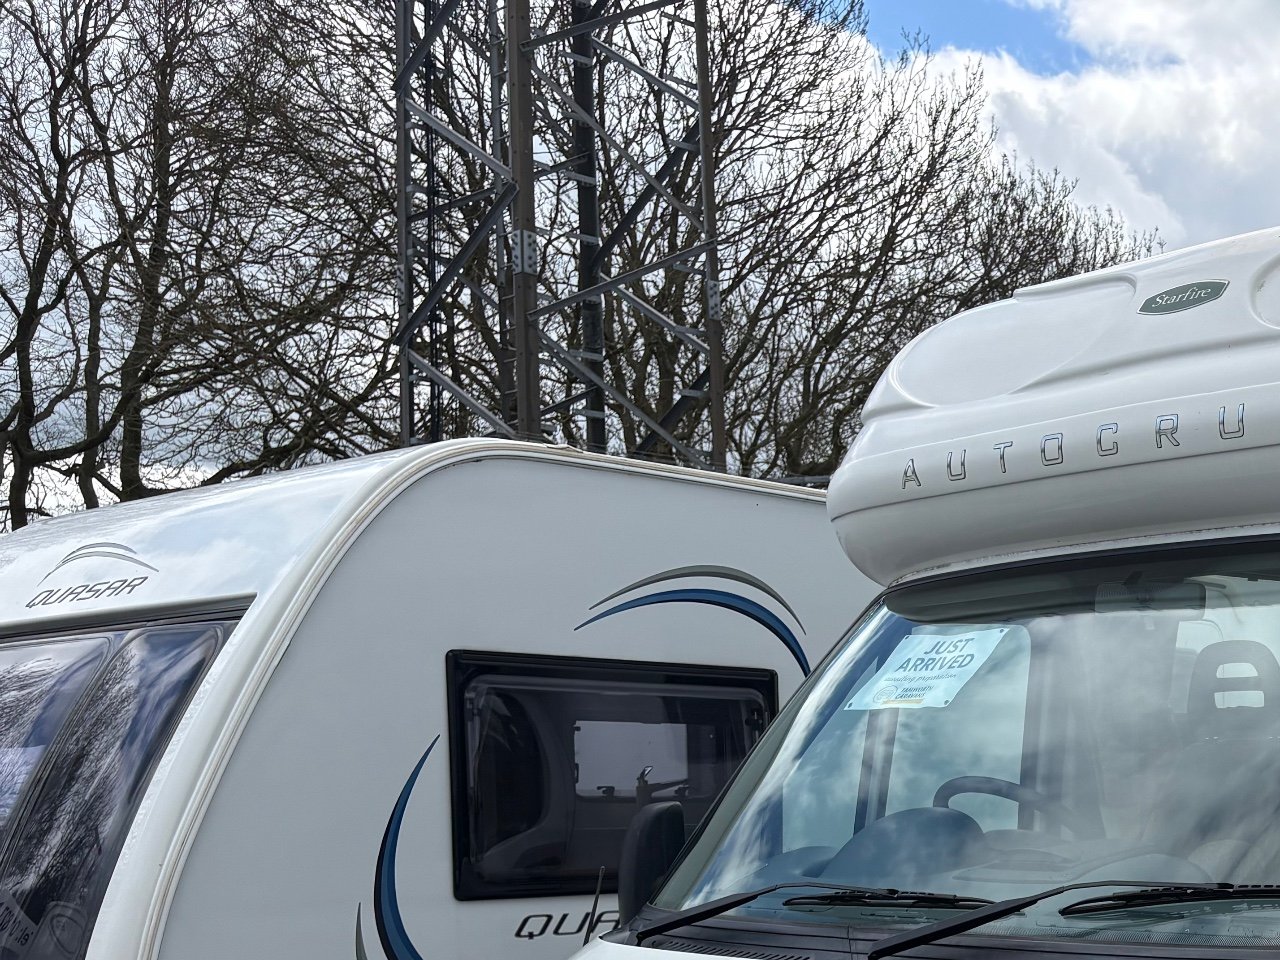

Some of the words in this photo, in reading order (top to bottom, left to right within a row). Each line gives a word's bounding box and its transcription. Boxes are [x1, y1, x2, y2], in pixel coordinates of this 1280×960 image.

[1151, 286, 1211, 307] Starfire
[25, 576, 148, 608] QUASAR
[924, 637, 975, 655] JUST
[895, 654, 975, 672] ARRIVED
